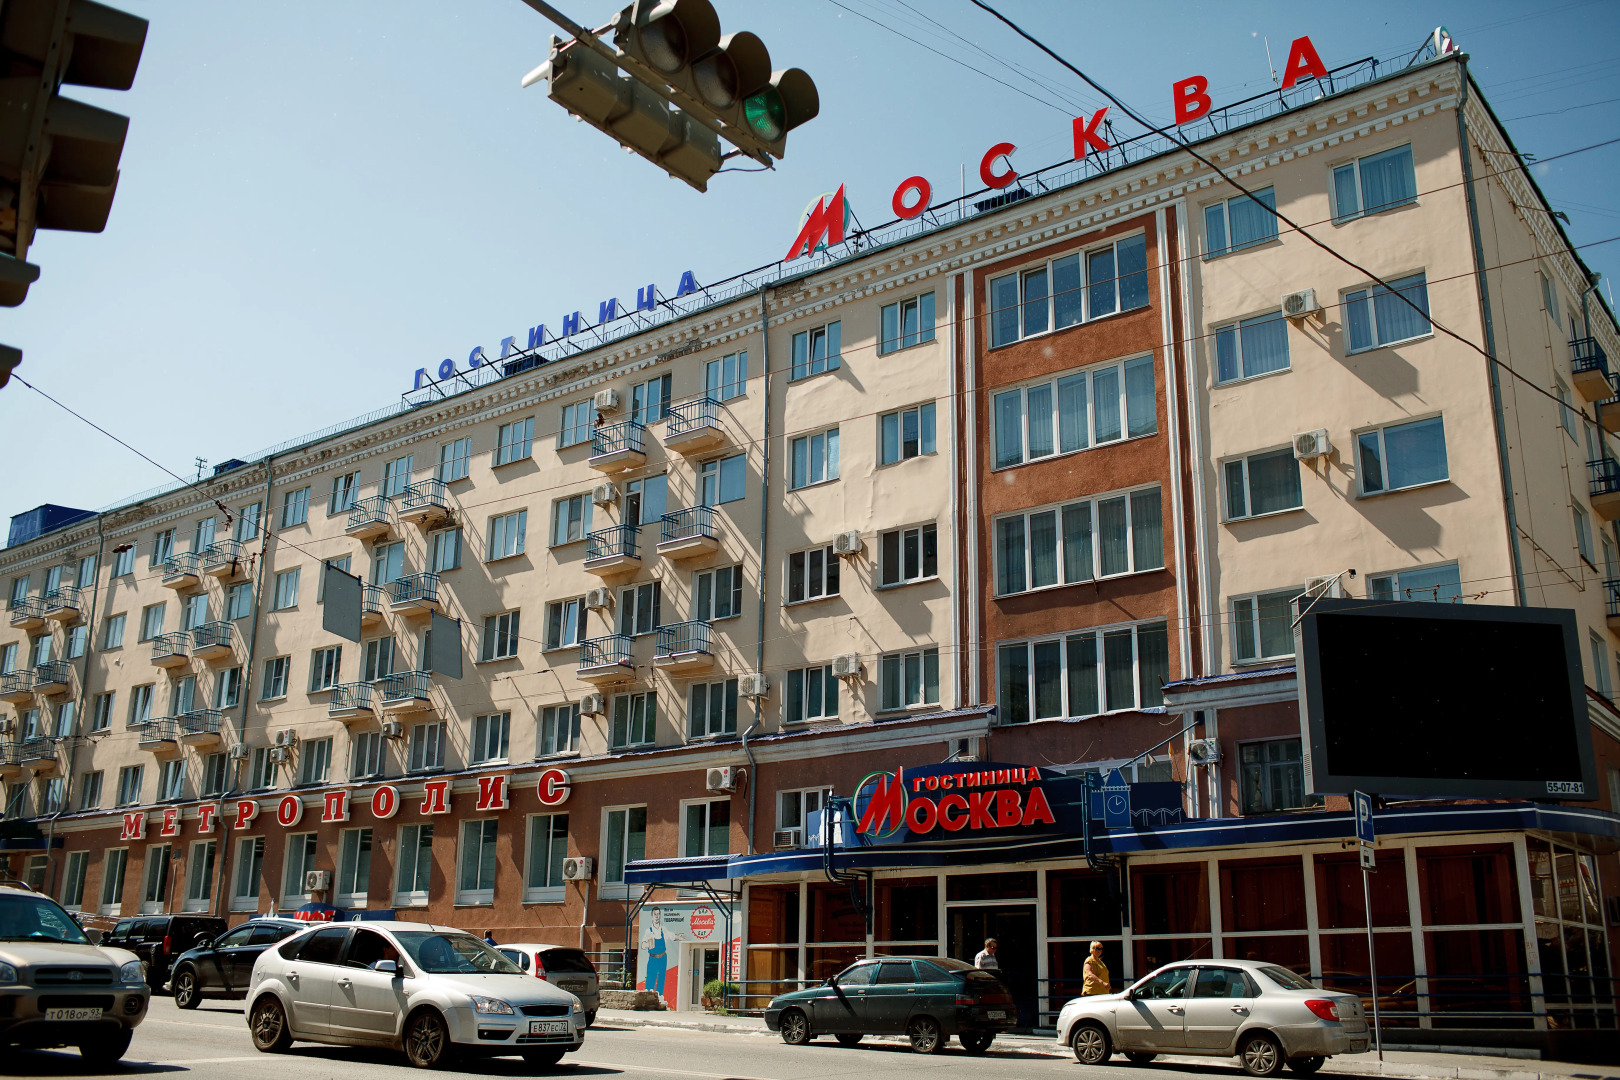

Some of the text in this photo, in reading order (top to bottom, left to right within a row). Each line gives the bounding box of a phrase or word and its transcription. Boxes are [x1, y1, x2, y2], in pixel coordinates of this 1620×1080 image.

[413, 35, 1330, 390] ГОСТИНИЦА МОСКВА
[120, 768, 571, 841] МЕТРОПОЛИС
[855, 765, 1056, 836] МОСКВА
[913, 766, 1042, 792] ГОСТИНИЦА
[1547, 782, 1584, 793] 55-07-81
